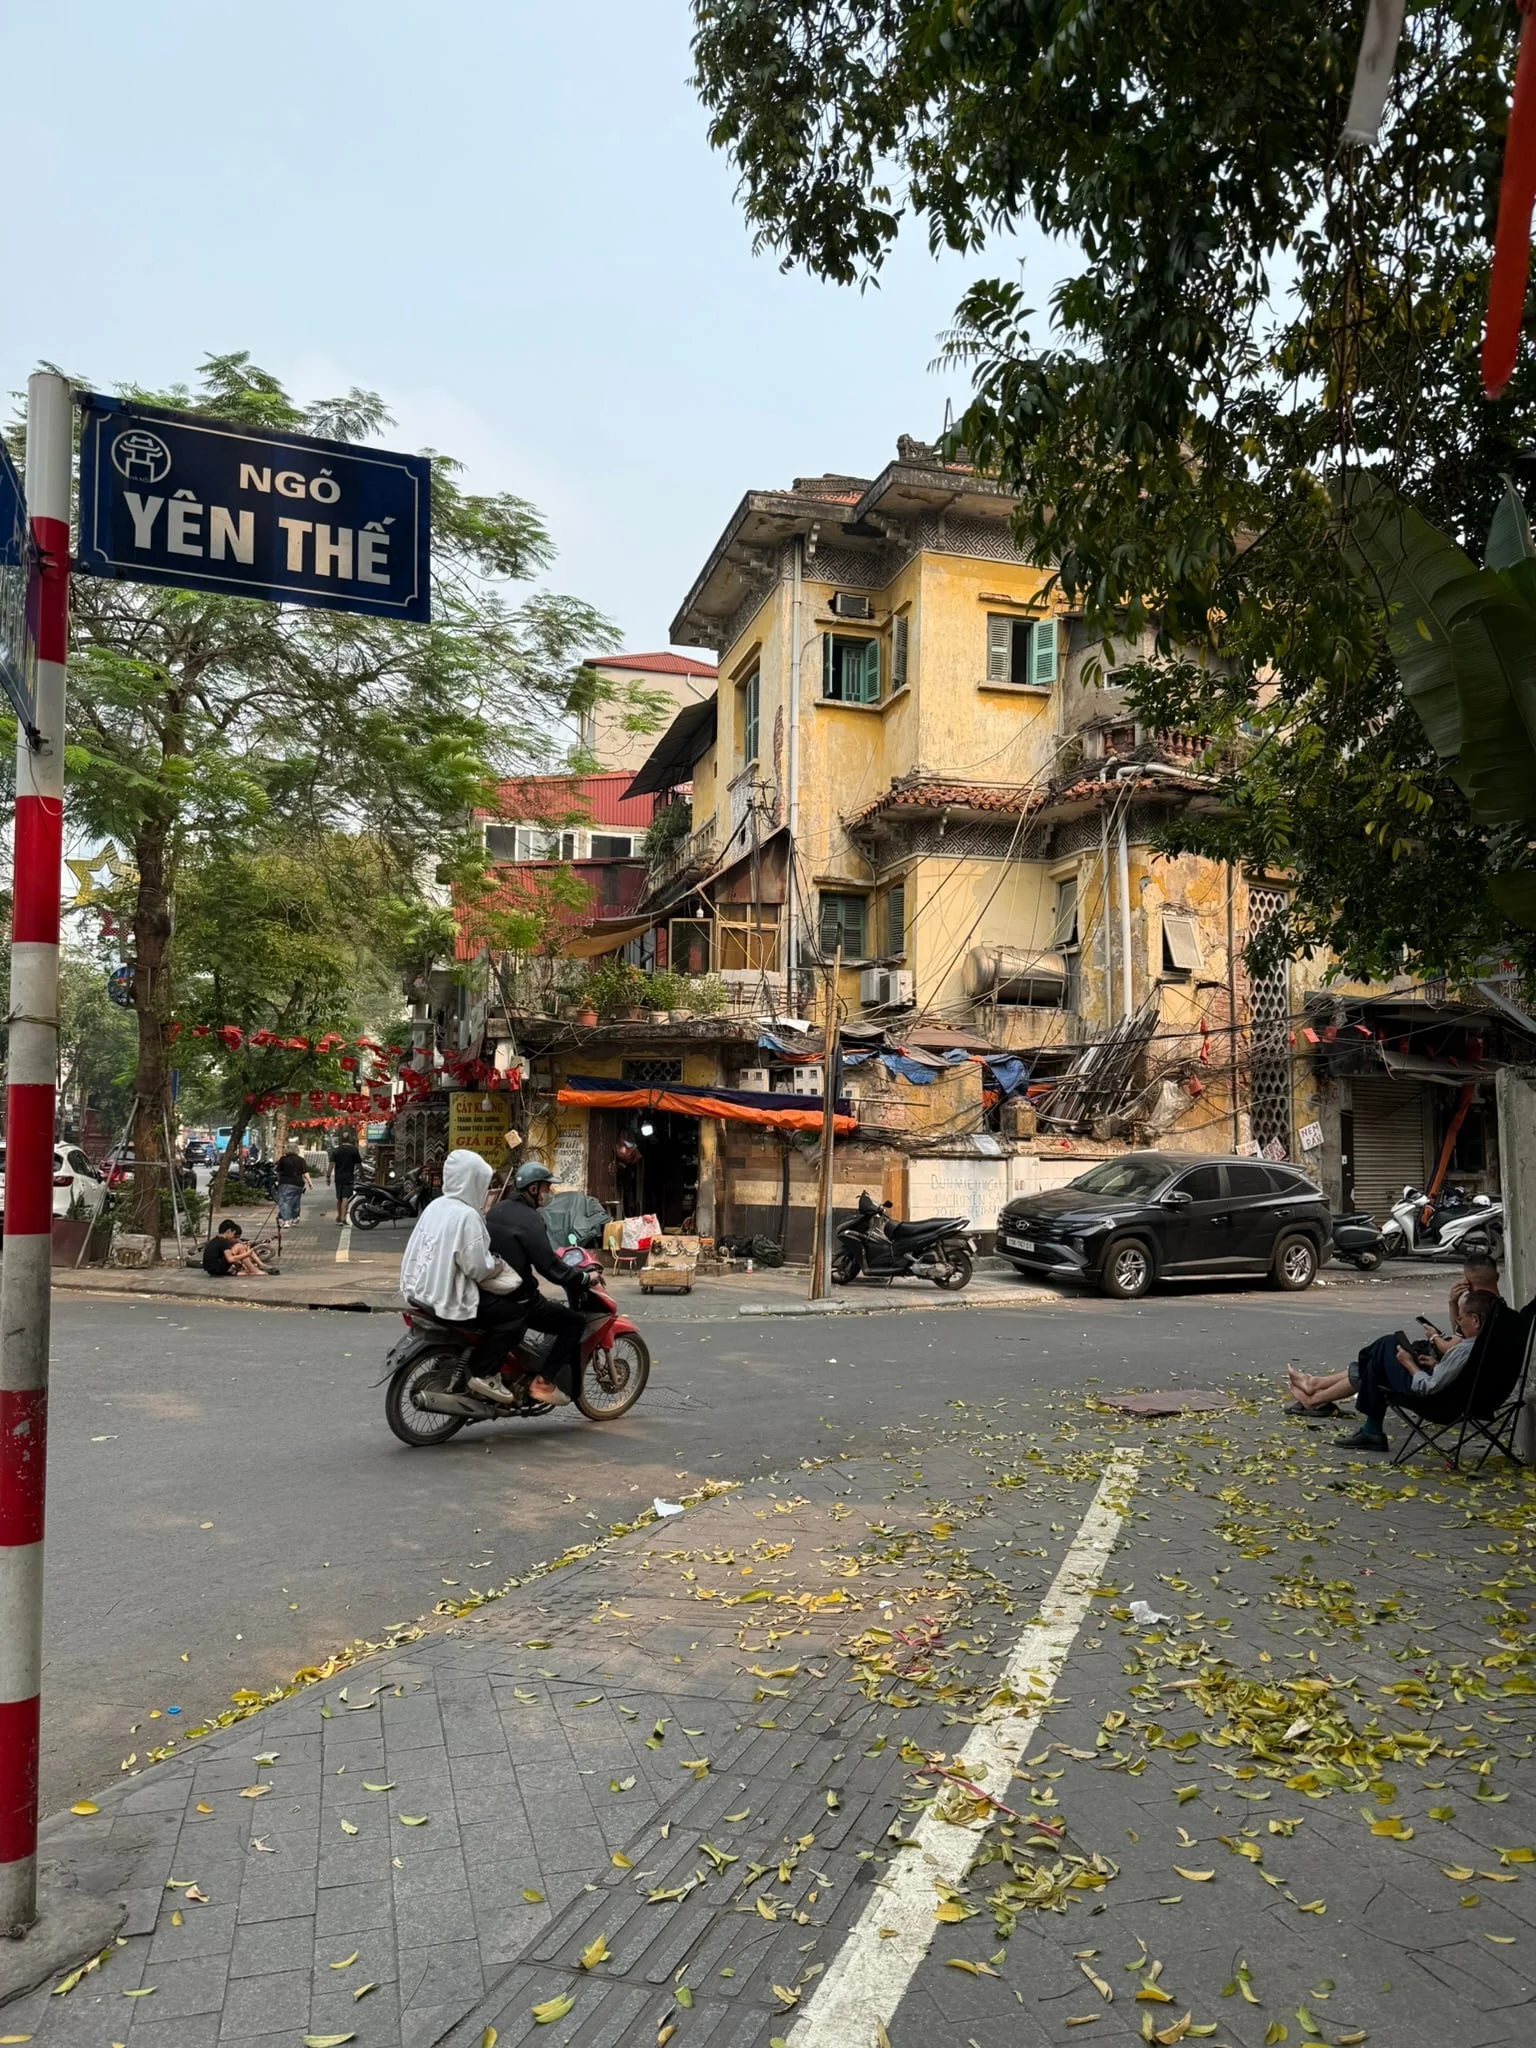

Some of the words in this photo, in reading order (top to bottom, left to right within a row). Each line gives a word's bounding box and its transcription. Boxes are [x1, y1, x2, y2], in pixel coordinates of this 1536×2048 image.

[240, 463, 341, 504] NGÕ
[123, 488, 254, 565] YÊN
[278, 517, 396, 585] THẾ
[456, 1134, 480, 1146] GIÁ
[1301, 1123, 1319, 1138] NEM
